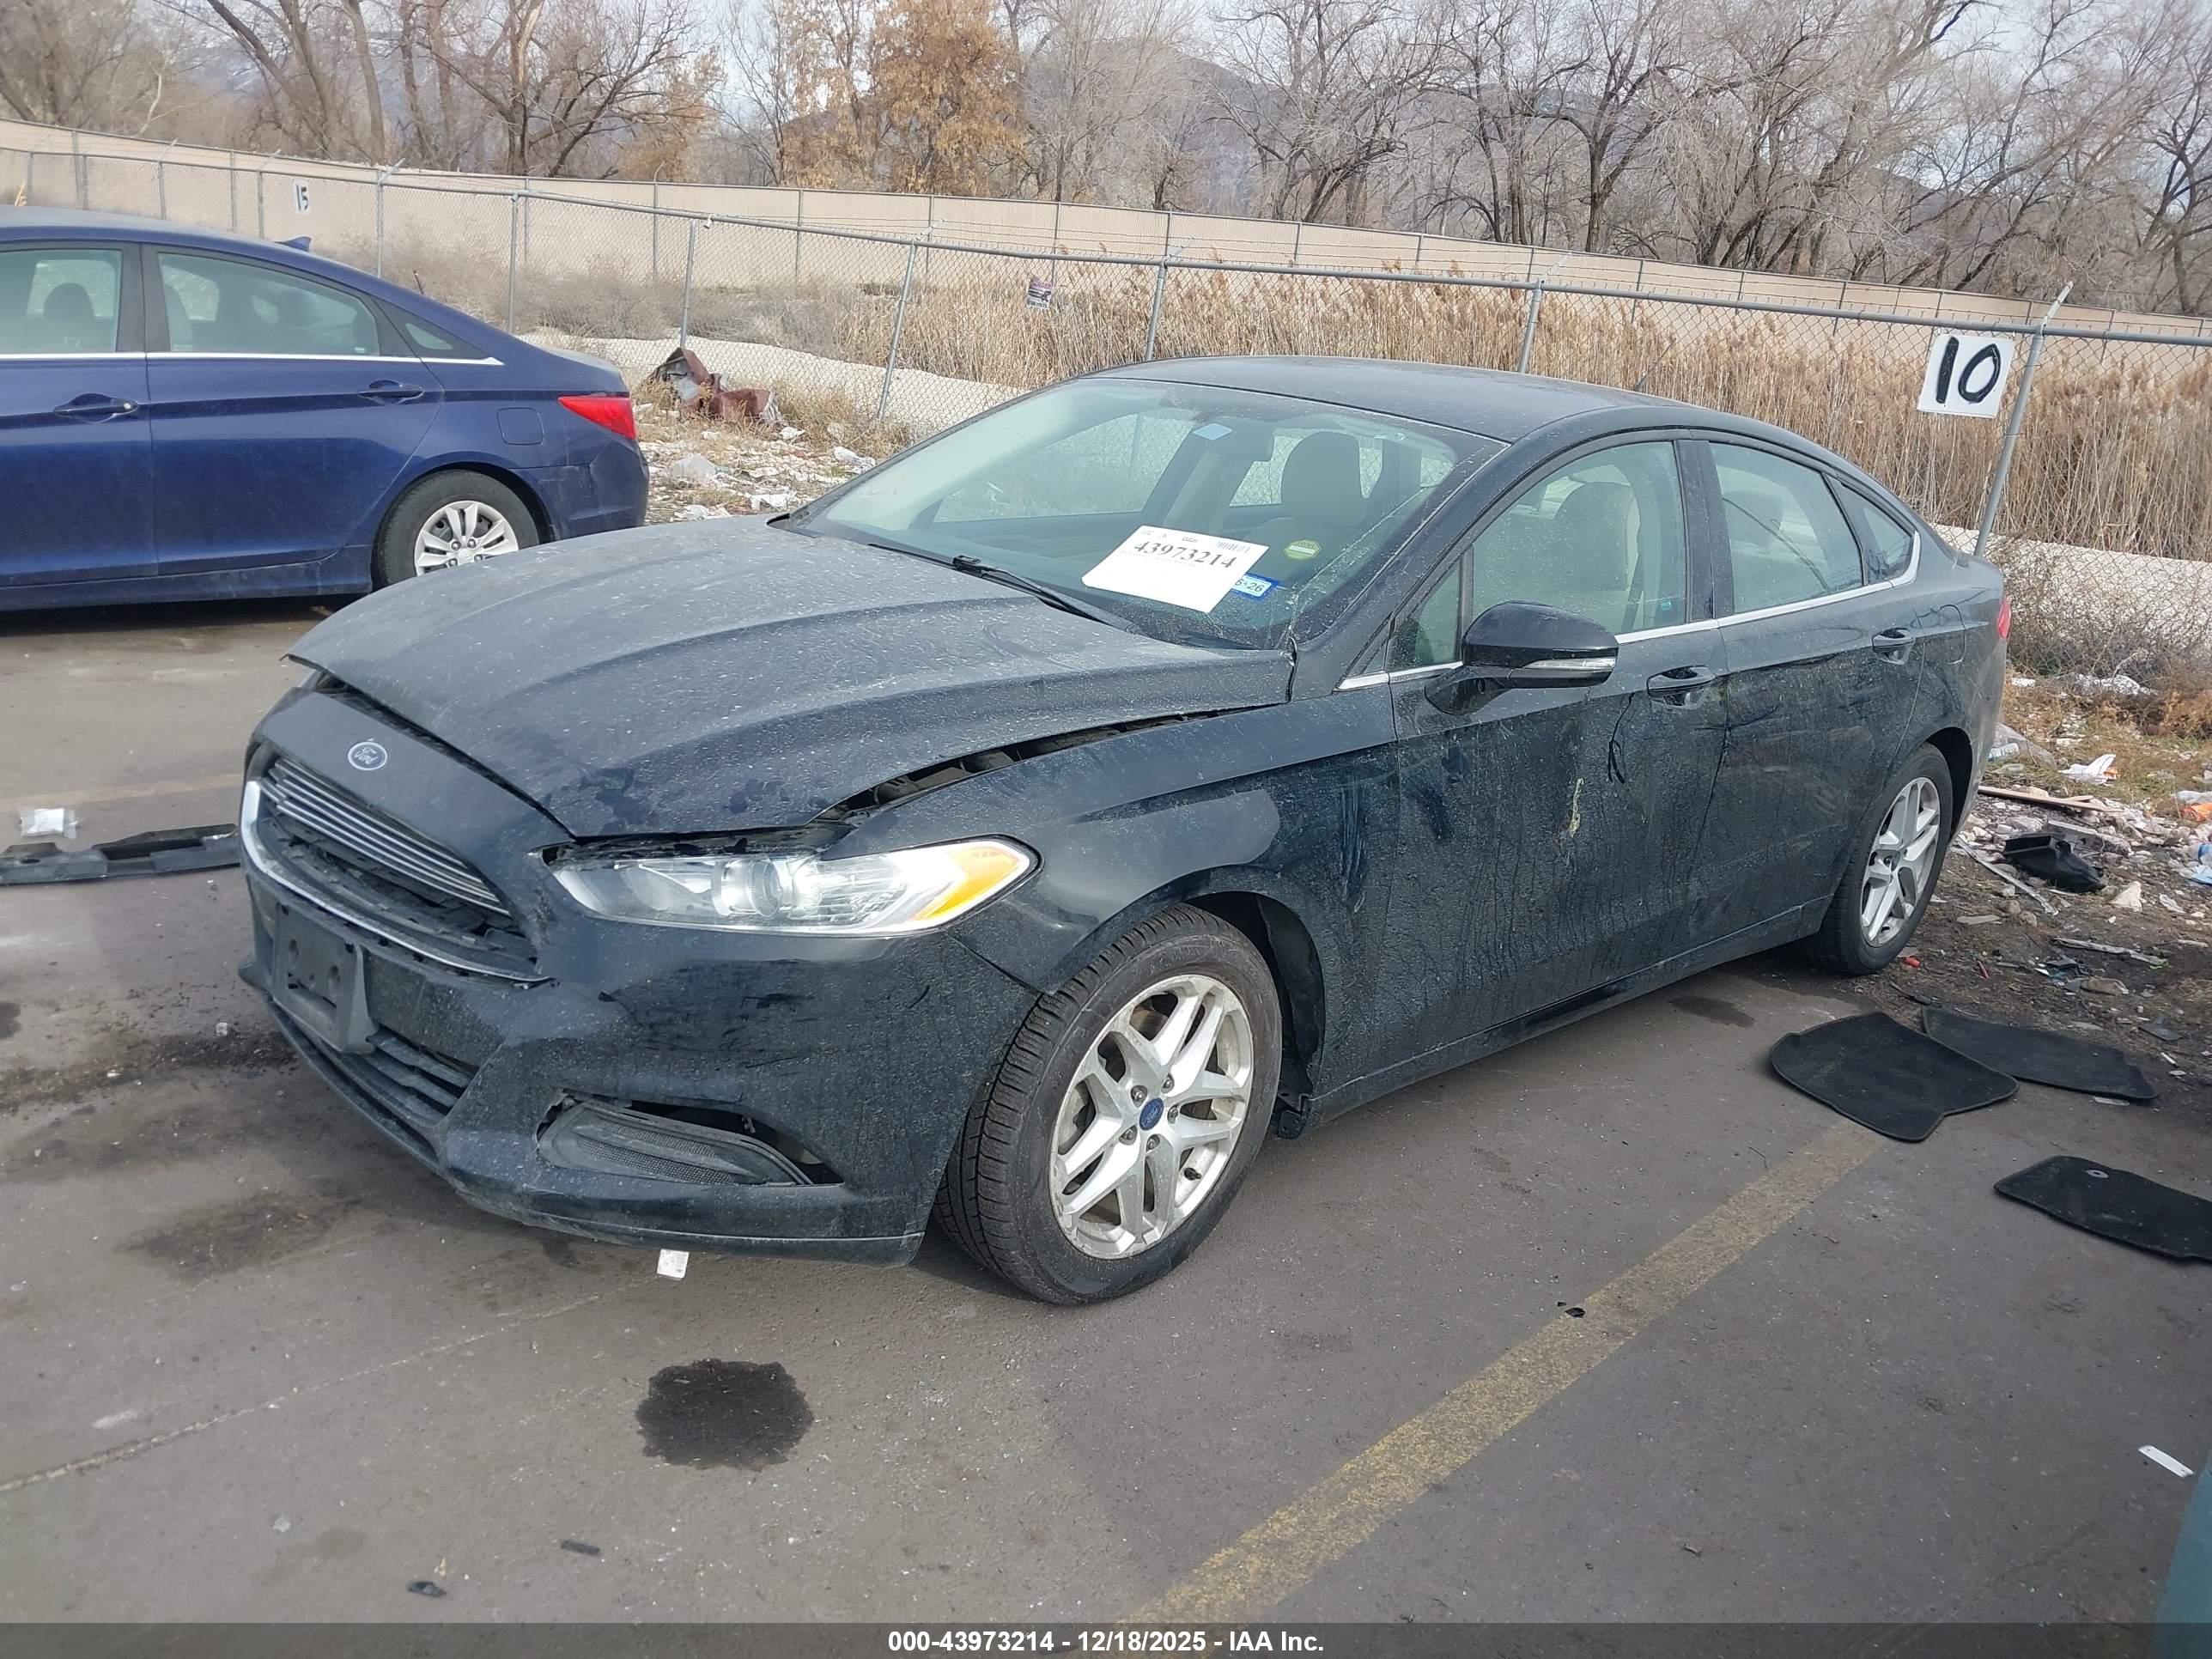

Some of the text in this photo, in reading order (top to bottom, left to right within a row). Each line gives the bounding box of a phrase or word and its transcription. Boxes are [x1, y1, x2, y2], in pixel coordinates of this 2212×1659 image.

[295, 184, 309, 211] 15
[1936, 336, 2002, 404] 10
[1133, 541, 1237, 568] 43973214
[1246, 582, 1265, 592] 26
